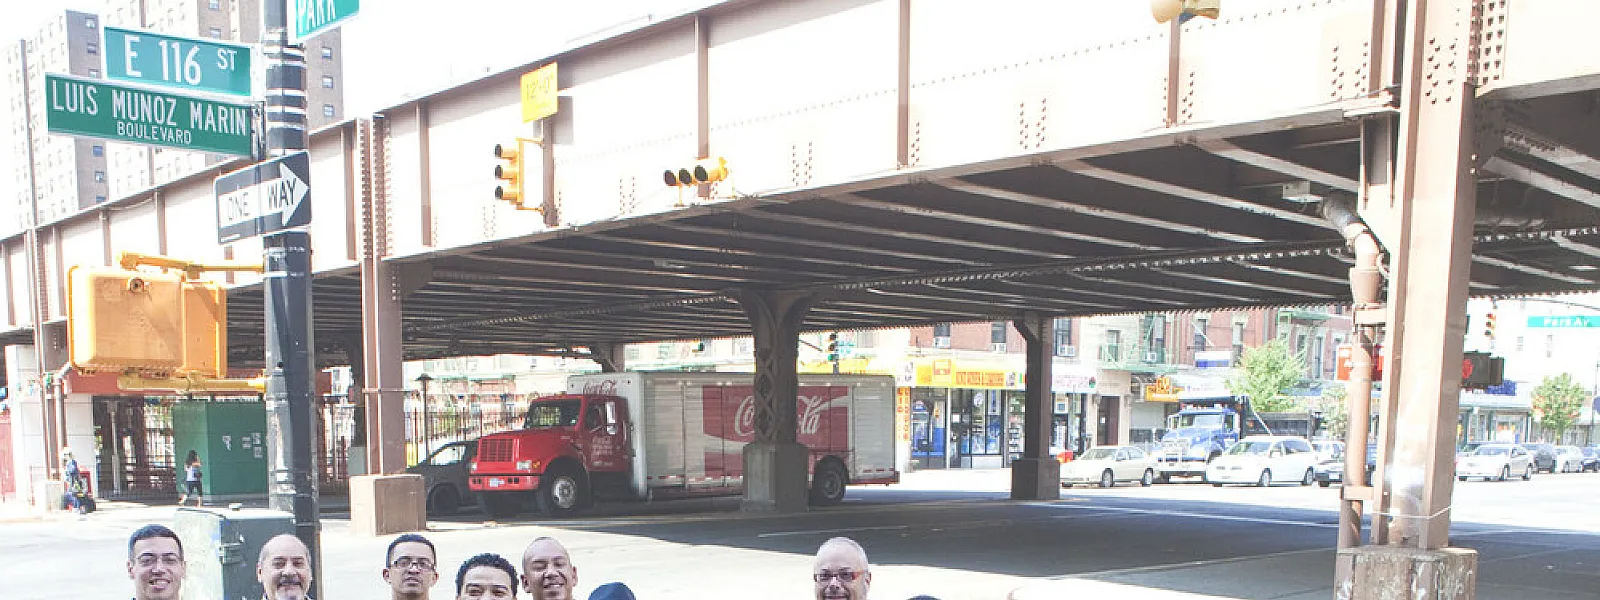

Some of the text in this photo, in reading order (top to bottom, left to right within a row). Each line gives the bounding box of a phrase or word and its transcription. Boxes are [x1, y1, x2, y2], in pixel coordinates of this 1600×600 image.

[298, 0, 336, 33] PARK
[124, 35, 238, 85] E 116 ST
[52, 79, 247, 136] LUIS MUNOZ MARIN
[117, 122, 192, 145] BOULEVARD
[228, 178, 297, 221] ONE WAY
